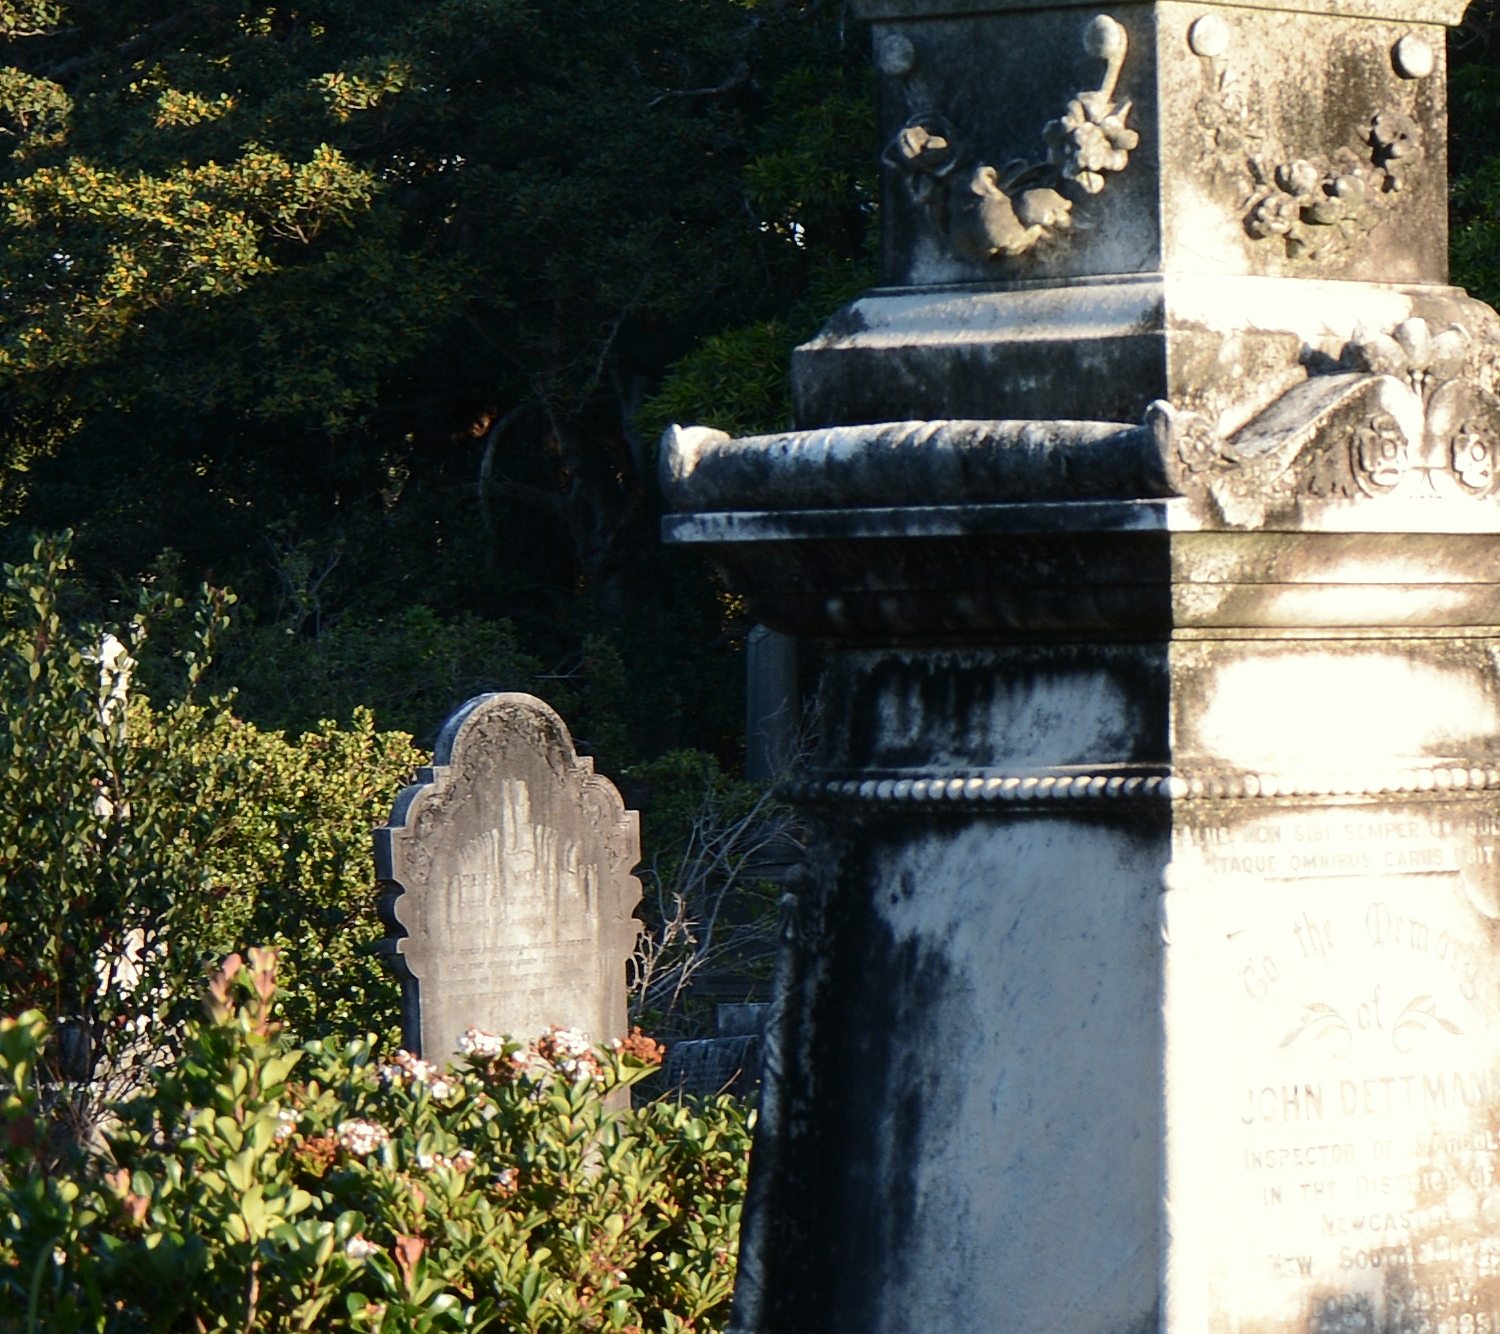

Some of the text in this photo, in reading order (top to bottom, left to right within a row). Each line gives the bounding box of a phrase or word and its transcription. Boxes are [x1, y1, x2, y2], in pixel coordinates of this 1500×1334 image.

[1295, 824, 1330, 843] SIBI
[1345, 820, 1419, 840] SEMPER
[1290, 853, 1371, 872] OMNIBUS
[1384, 849, 1444, 868] CARUS
[1293, 911, 1334, 966] the
[1357, 982, 1383, 1031] of
[1240, 1082, 1325, 1125] JOHN
[1373, 1139, 1395, 1159] OF
[1263, 1186, 1282, 1206] IN
[1300, 1181, 1337, 1204] THE
